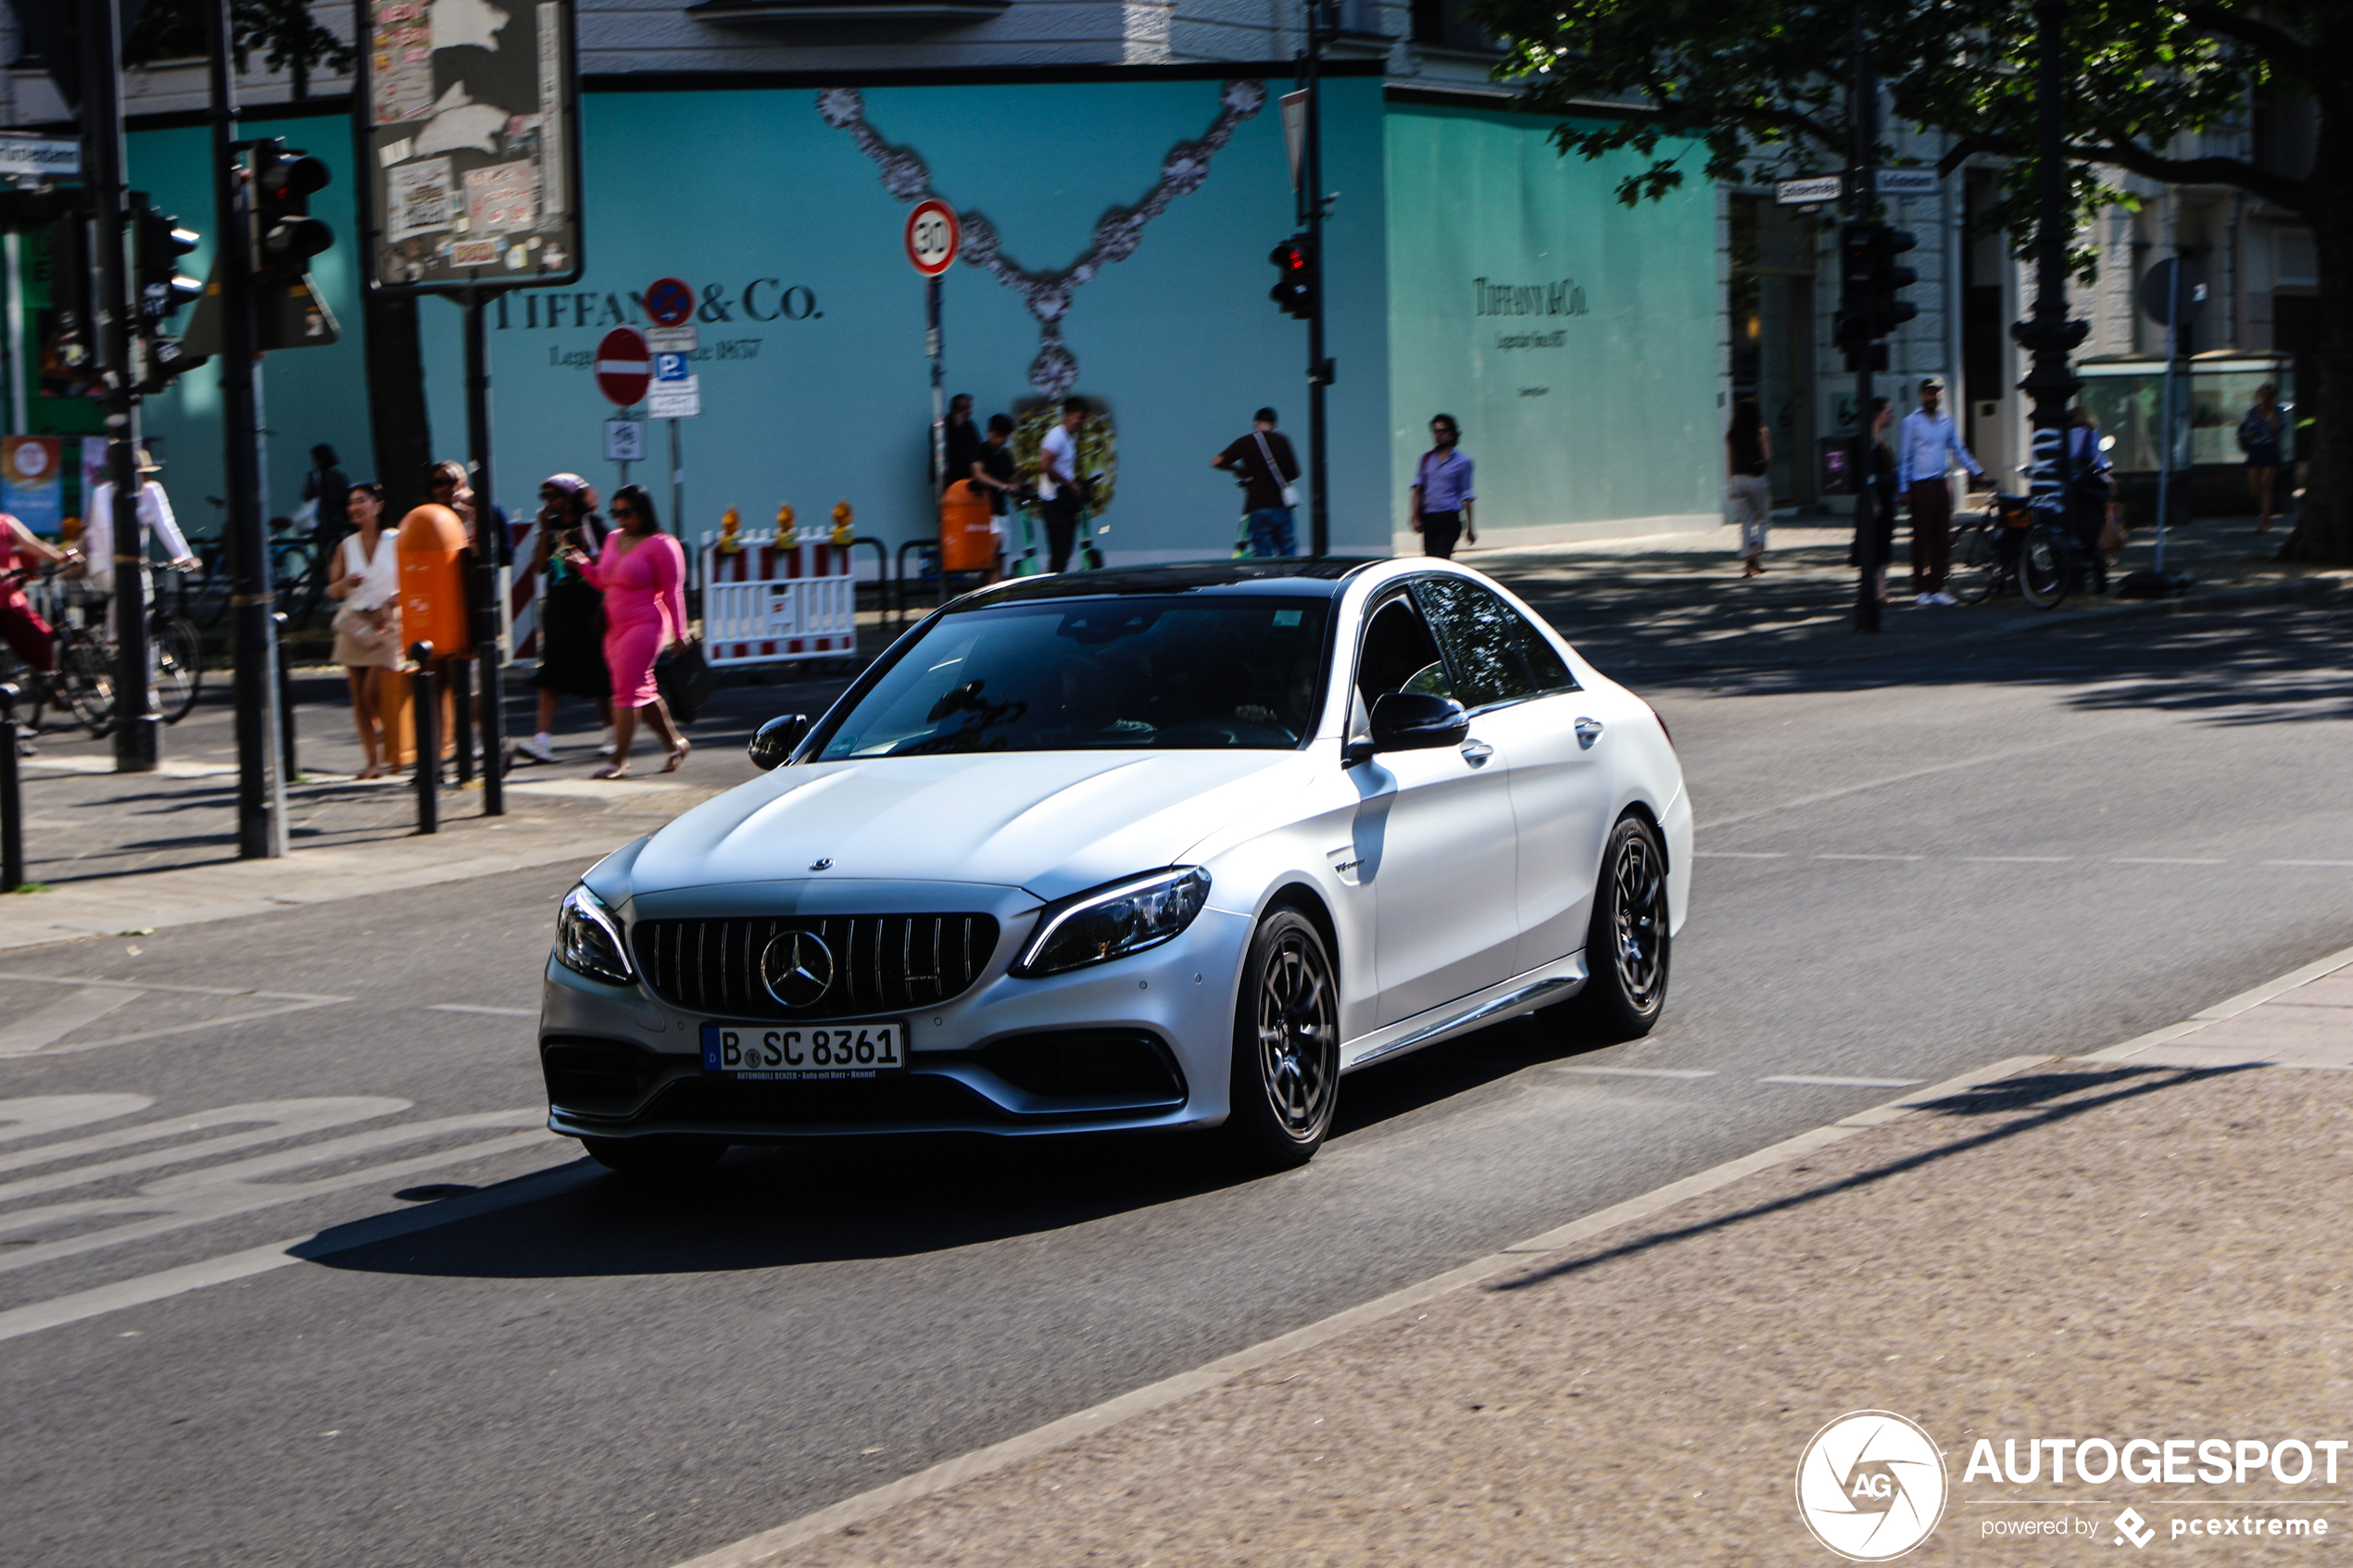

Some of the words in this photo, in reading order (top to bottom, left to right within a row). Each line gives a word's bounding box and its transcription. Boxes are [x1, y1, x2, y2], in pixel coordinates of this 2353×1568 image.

[914, 220, 949, 255] 30
[697, 282, 736, 323] &
[709, 1052, 716, 1062] D
[723, 1032, 742, 1065] B
[762, 1031, 804, 1066] SC
[812, 1029, 898, 1065] 8361
